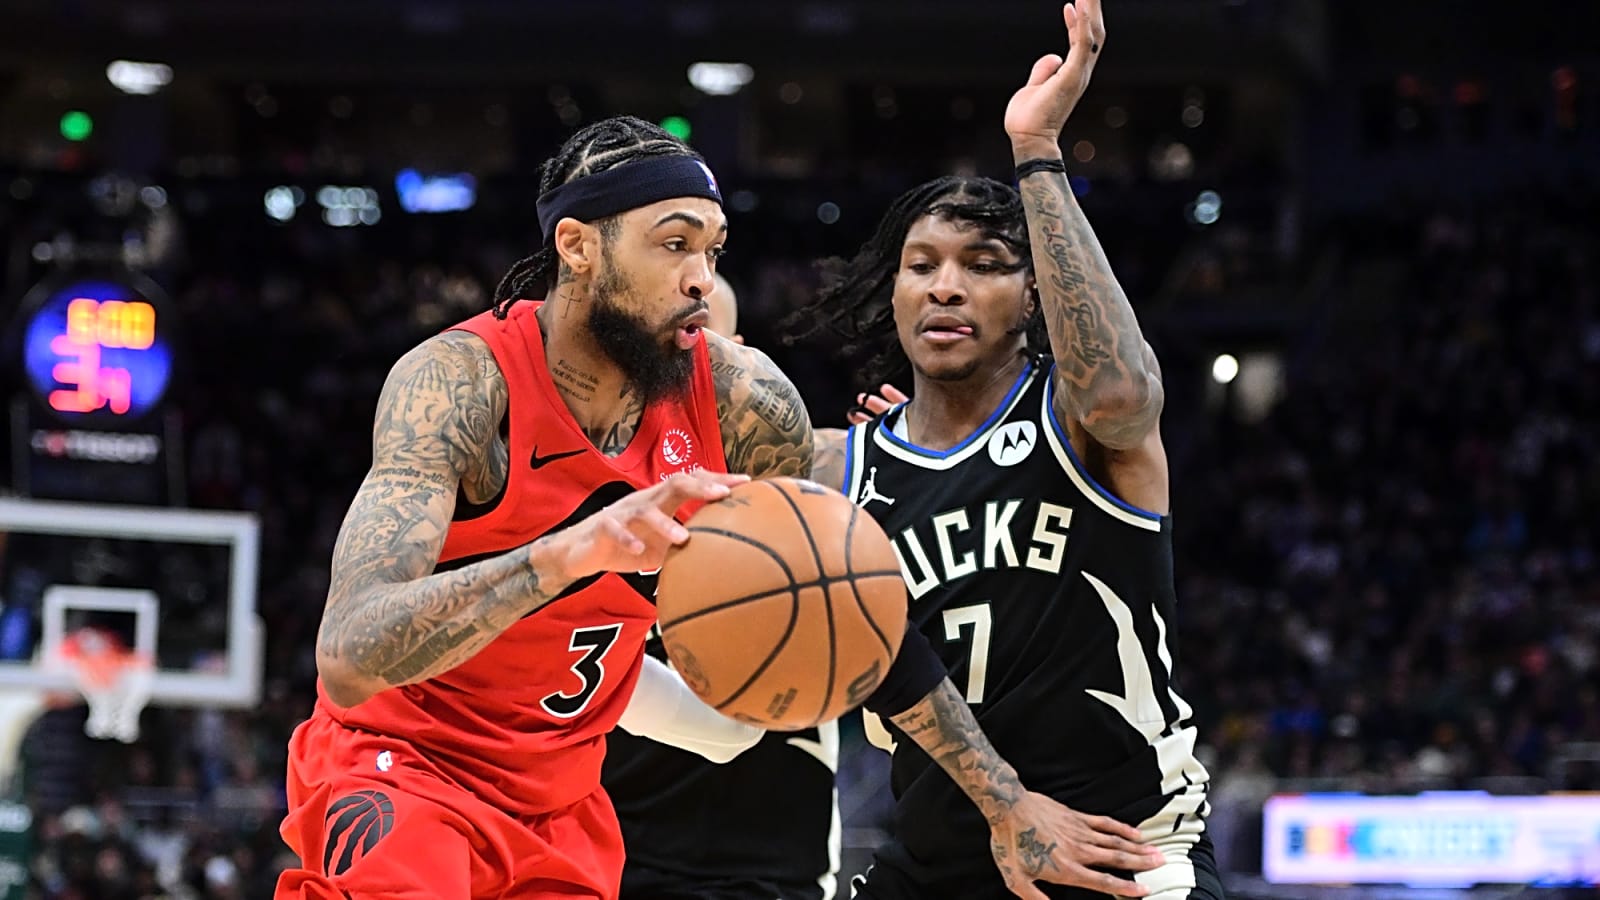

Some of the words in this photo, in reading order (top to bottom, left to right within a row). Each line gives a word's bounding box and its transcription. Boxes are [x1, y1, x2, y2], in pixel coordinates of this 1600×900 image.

[890, 498, 1074, 601] UCKS
[539, 622, 625, 719] 3
[942, 600, 993, 705] 7
